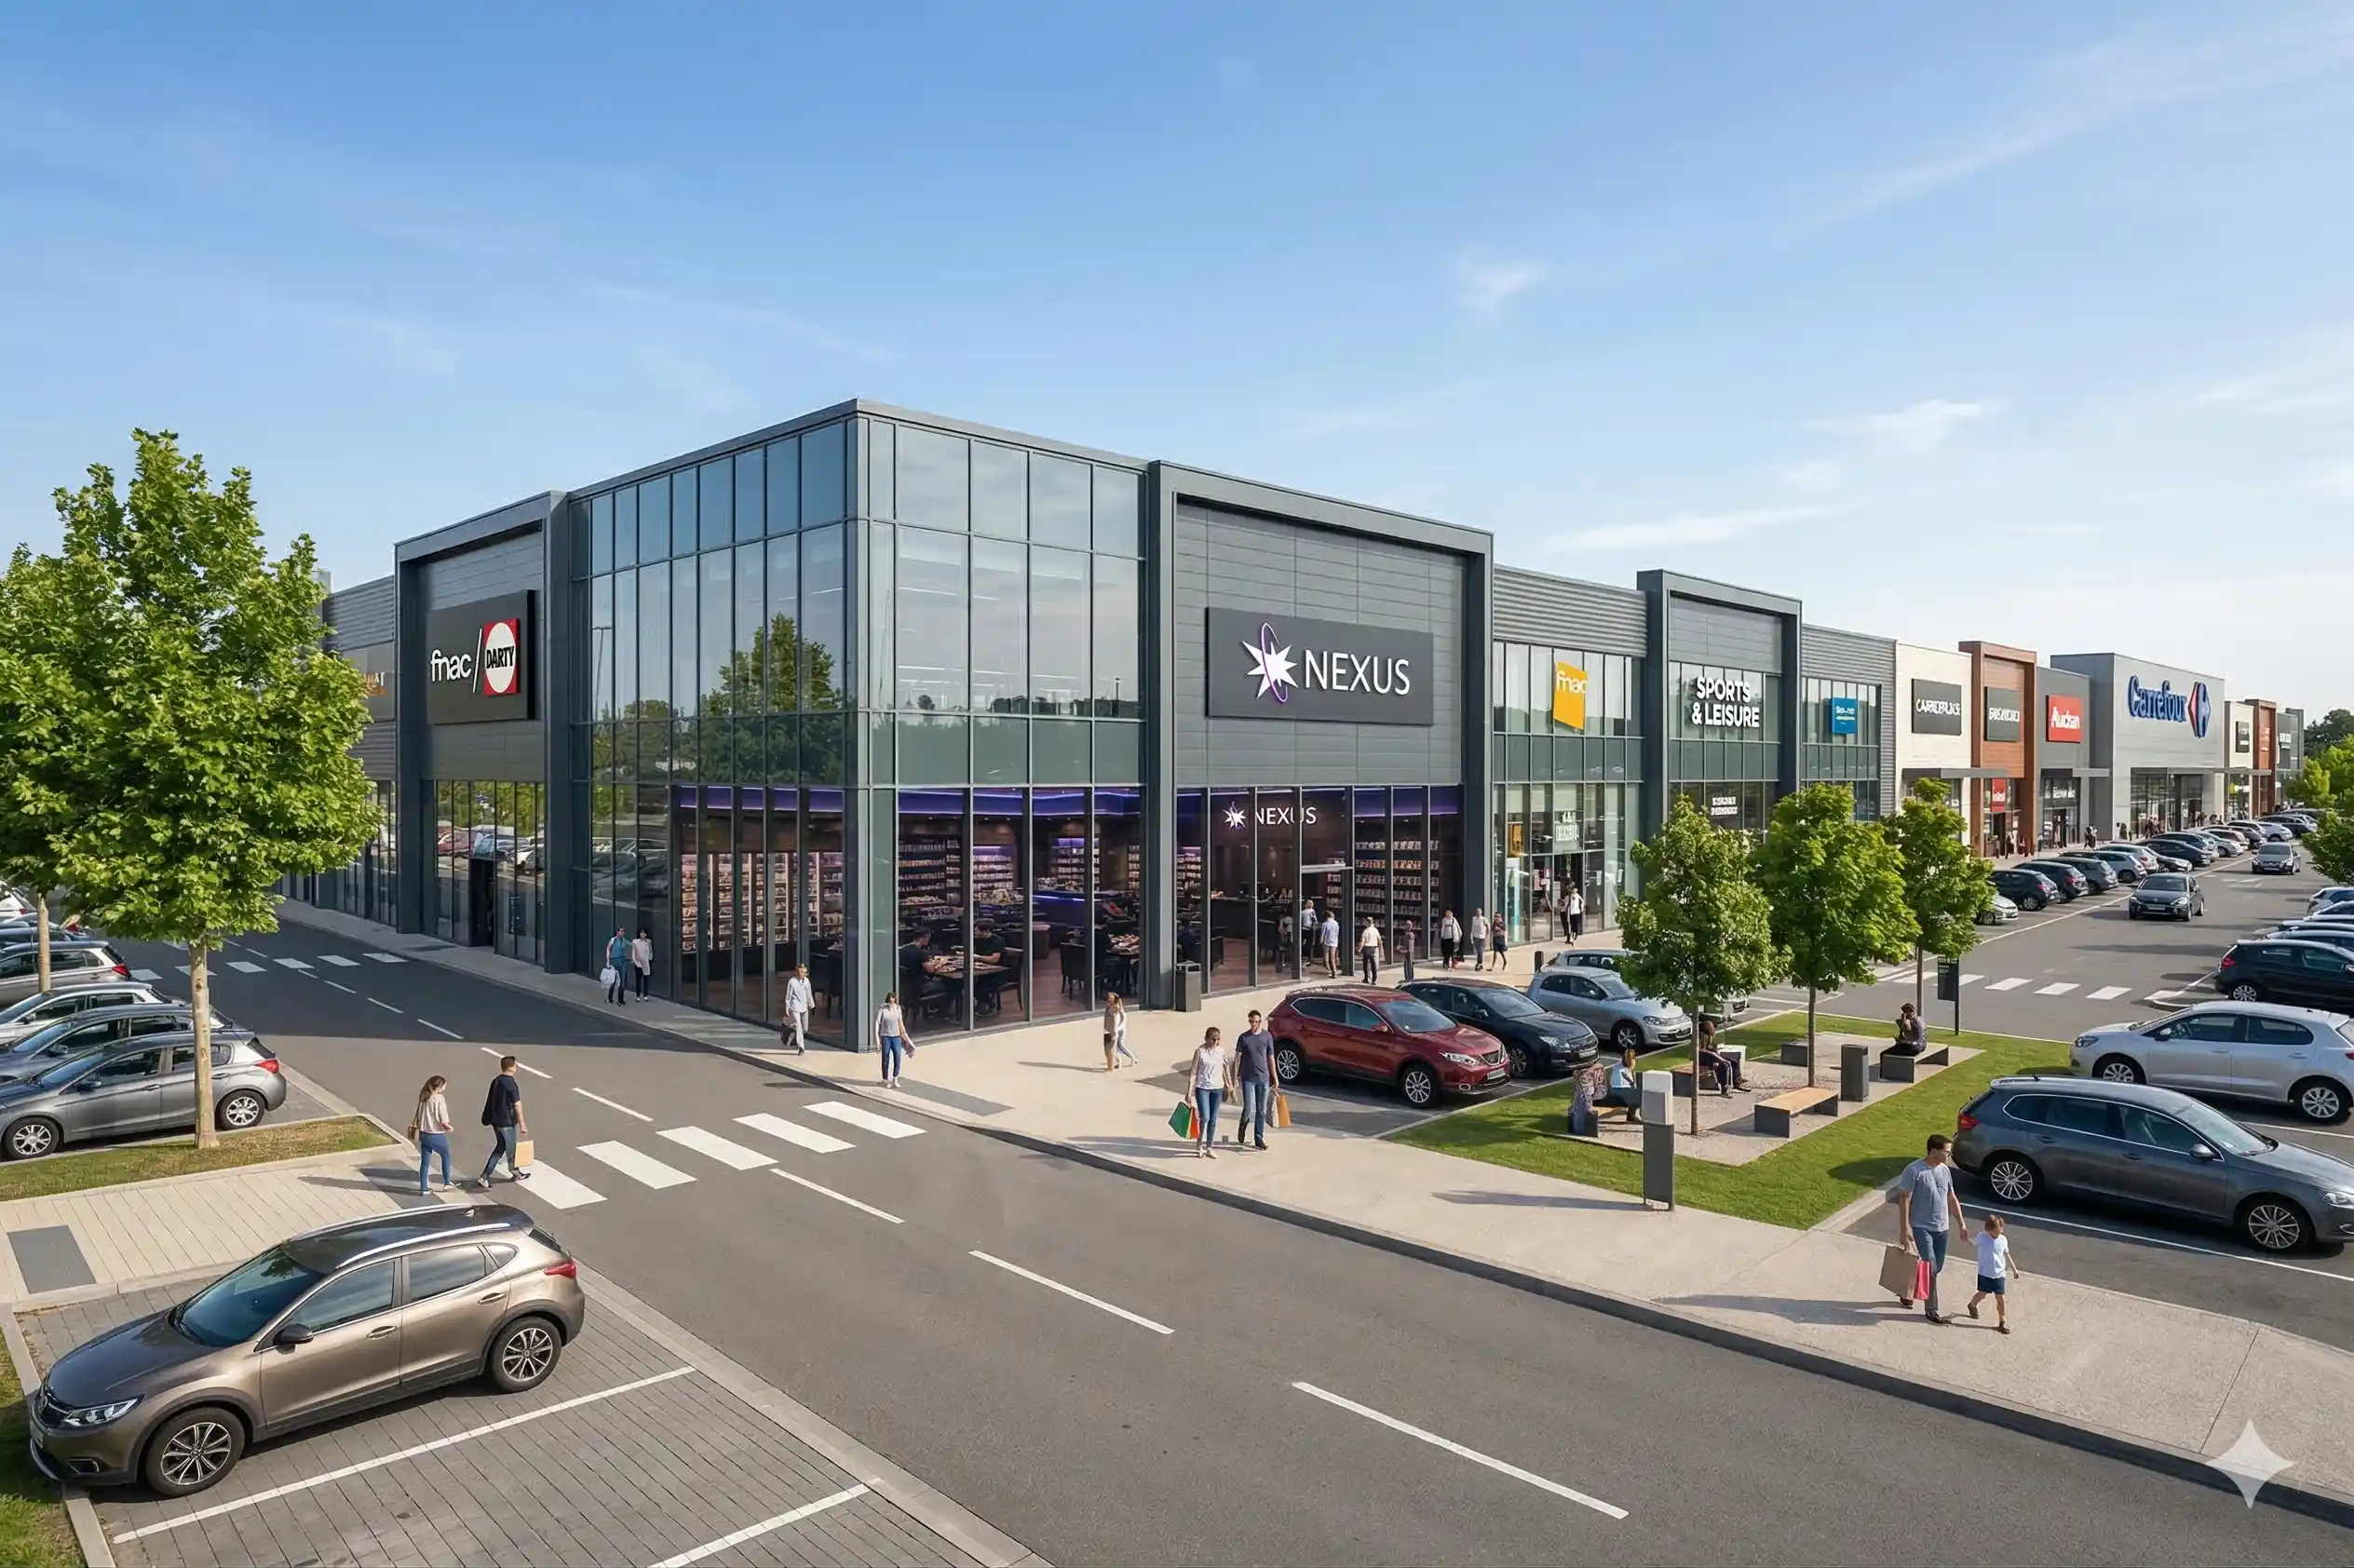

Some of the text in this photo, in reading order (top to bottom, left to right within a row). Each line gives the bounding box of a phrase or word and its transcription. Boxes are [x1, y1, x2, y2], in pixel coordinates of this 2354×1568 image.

[430, 645, 515, 682] fnac DARTY
[1305, 649, 1411, 696] NEXUS
[1556, 670, 1587, 694] fnac
[1697, 675, 1752, 703] SPORTS
[1691, 701, 1760, 727] & LEISURE
[2128, 675, 2187, 723] Carrefour
